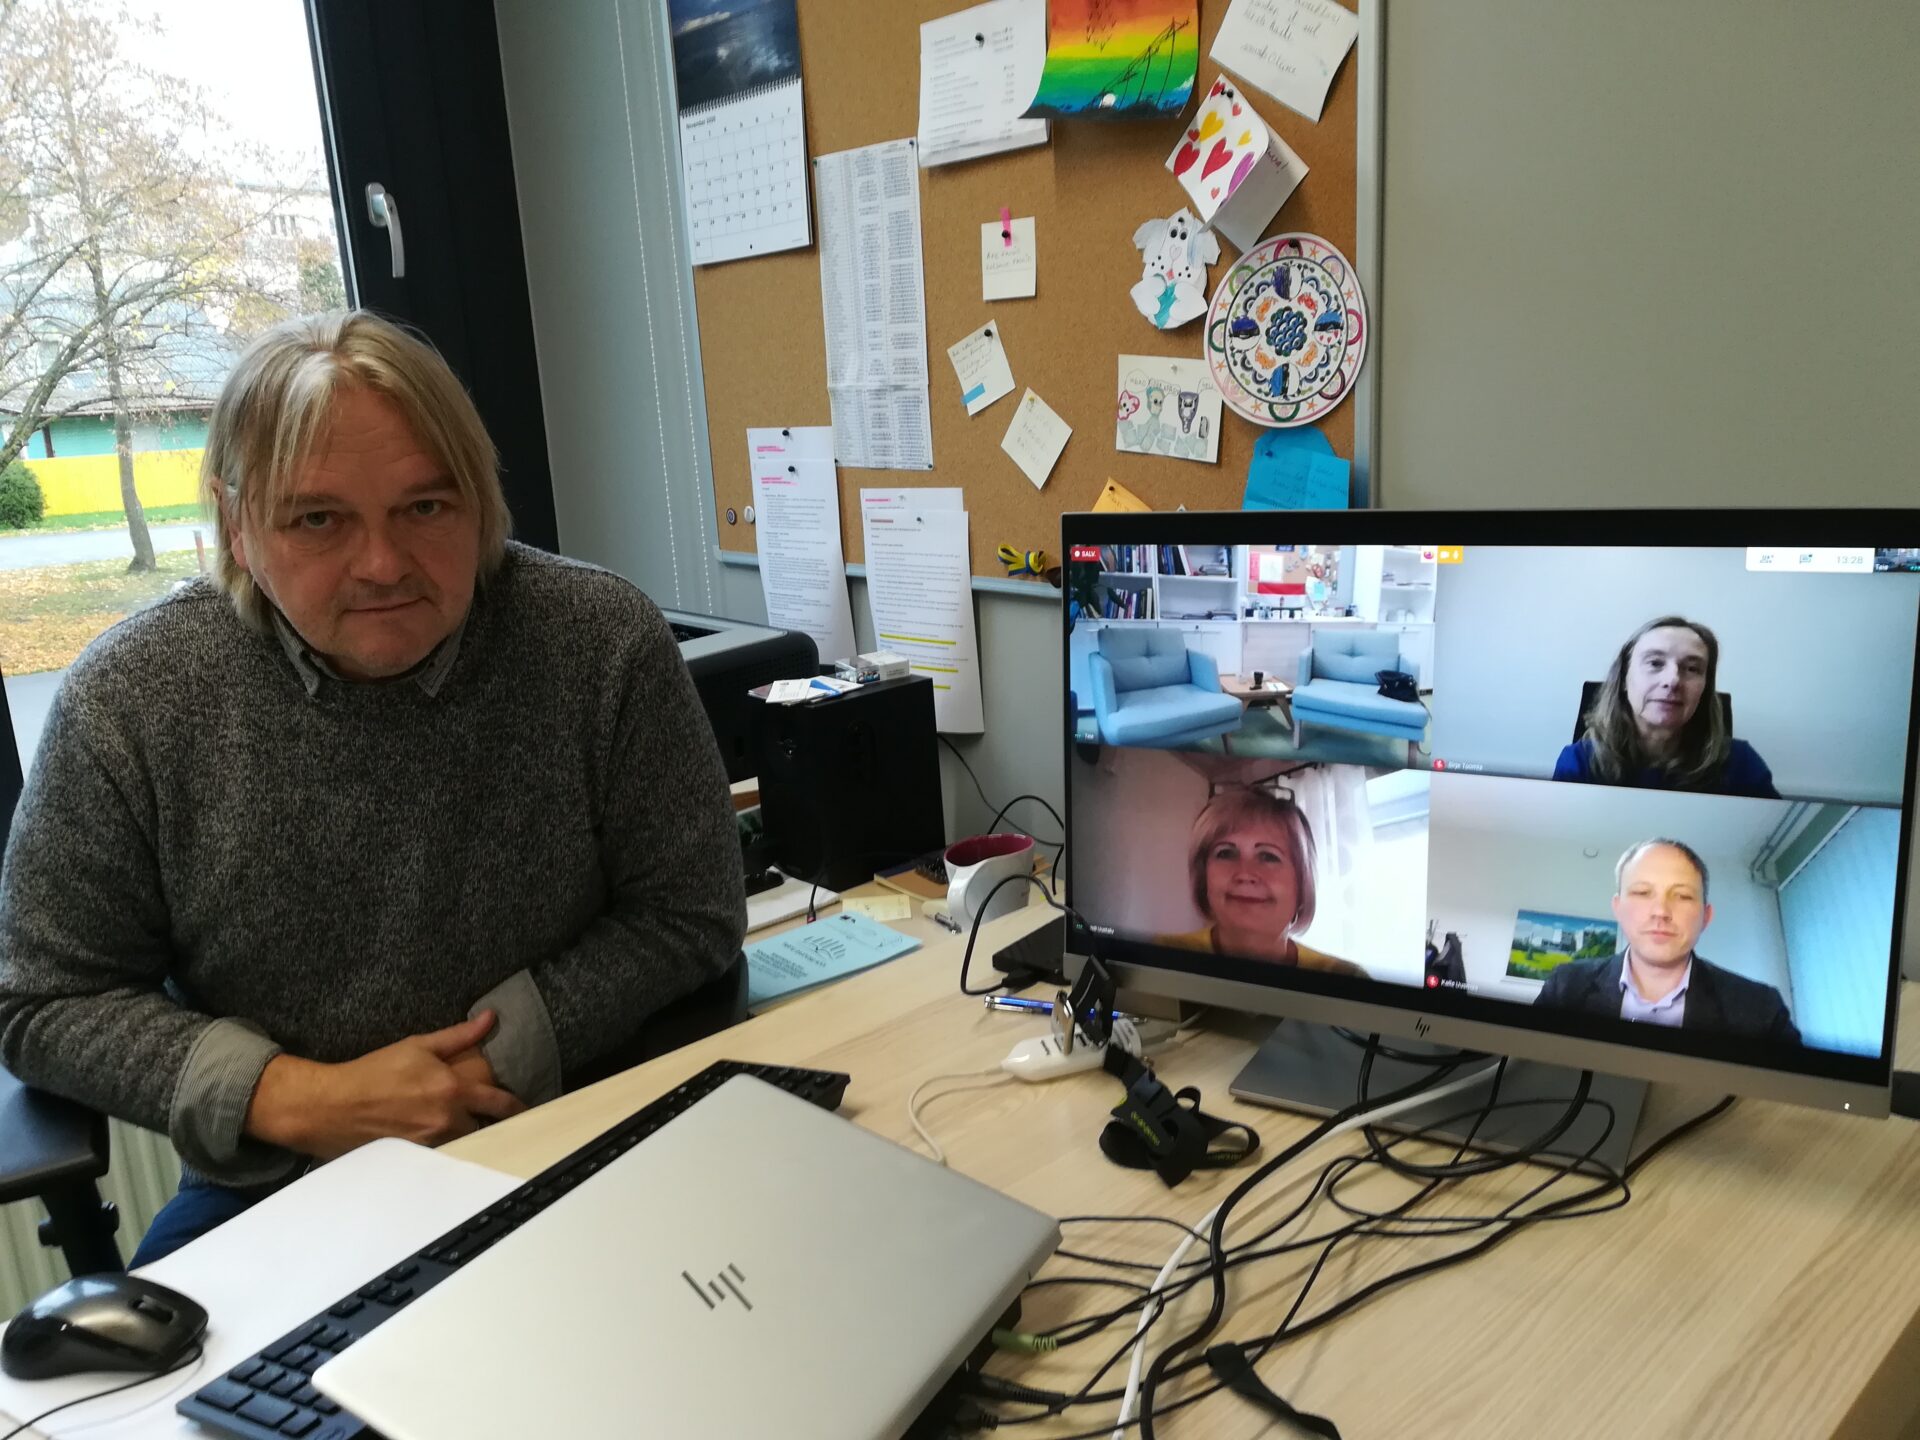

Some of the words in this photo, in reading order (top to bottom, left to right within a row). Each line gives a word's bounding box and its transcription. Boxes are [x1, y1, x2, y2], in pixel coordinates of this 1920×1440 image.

[1836, 556, 1864, 564] 13:28
[1414, 1016, 1430, 1038] hp
[681, 1262, 754, 1312] hp
